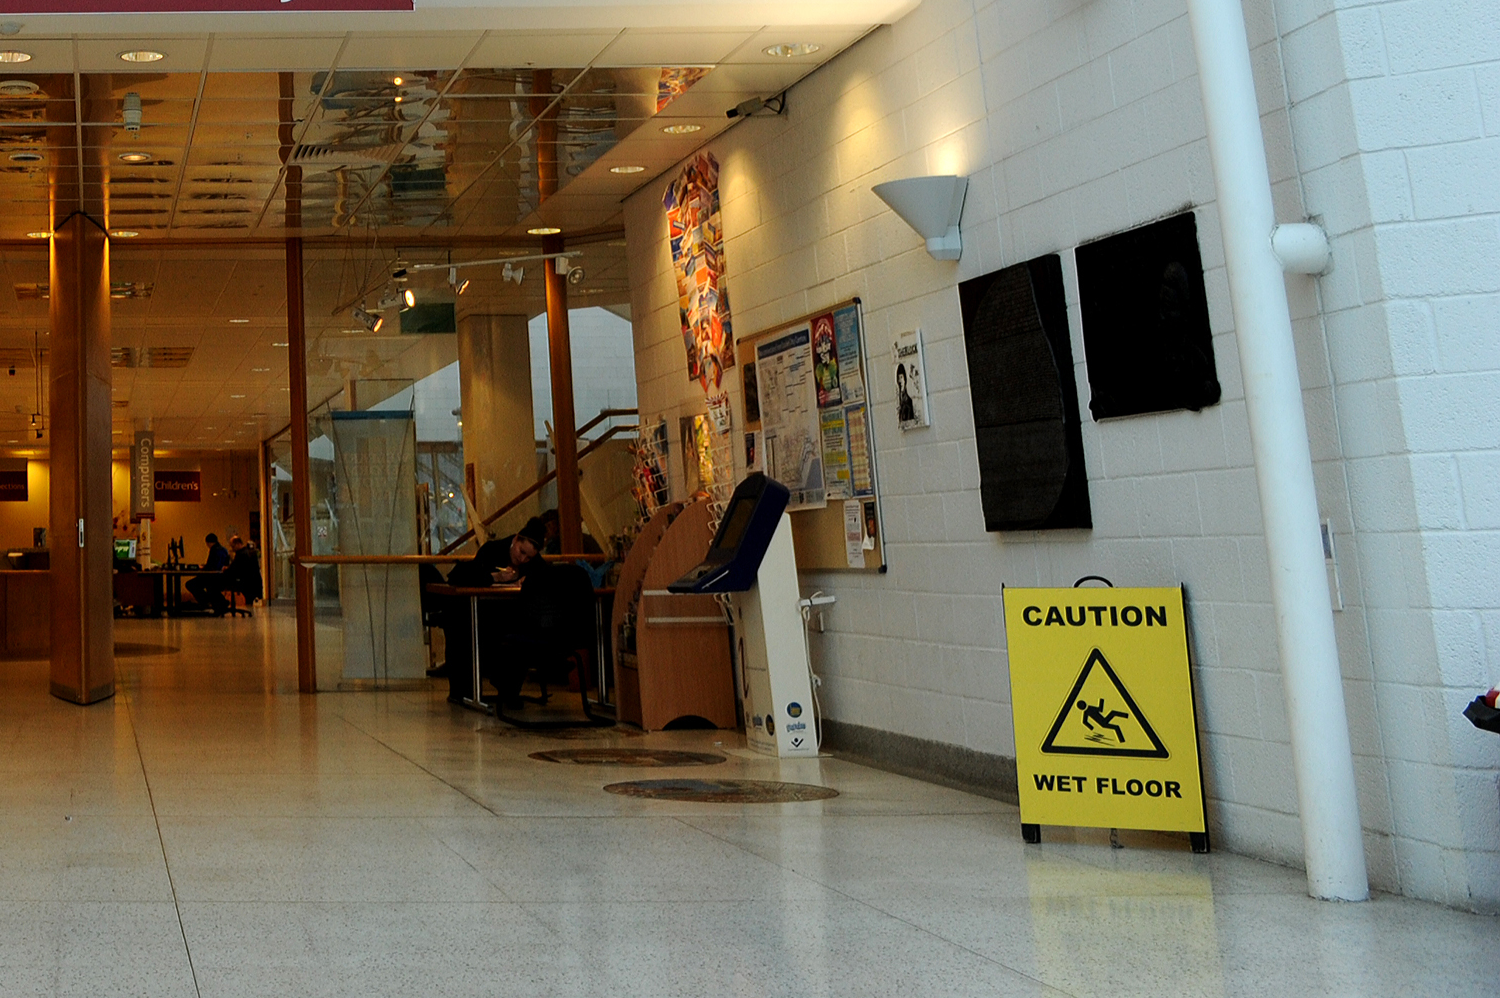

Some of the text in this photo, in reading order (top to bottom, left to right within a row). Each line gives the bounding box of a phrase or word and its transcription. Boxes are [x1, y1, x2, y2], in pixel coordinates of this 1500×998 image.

[138, 438, 152, 508] Computers
[155, 480, 199, 491] Children's
[1022, 605, 1168, 627] CAUTION
[1033, 774, 1182, 799] WET FLOOR
